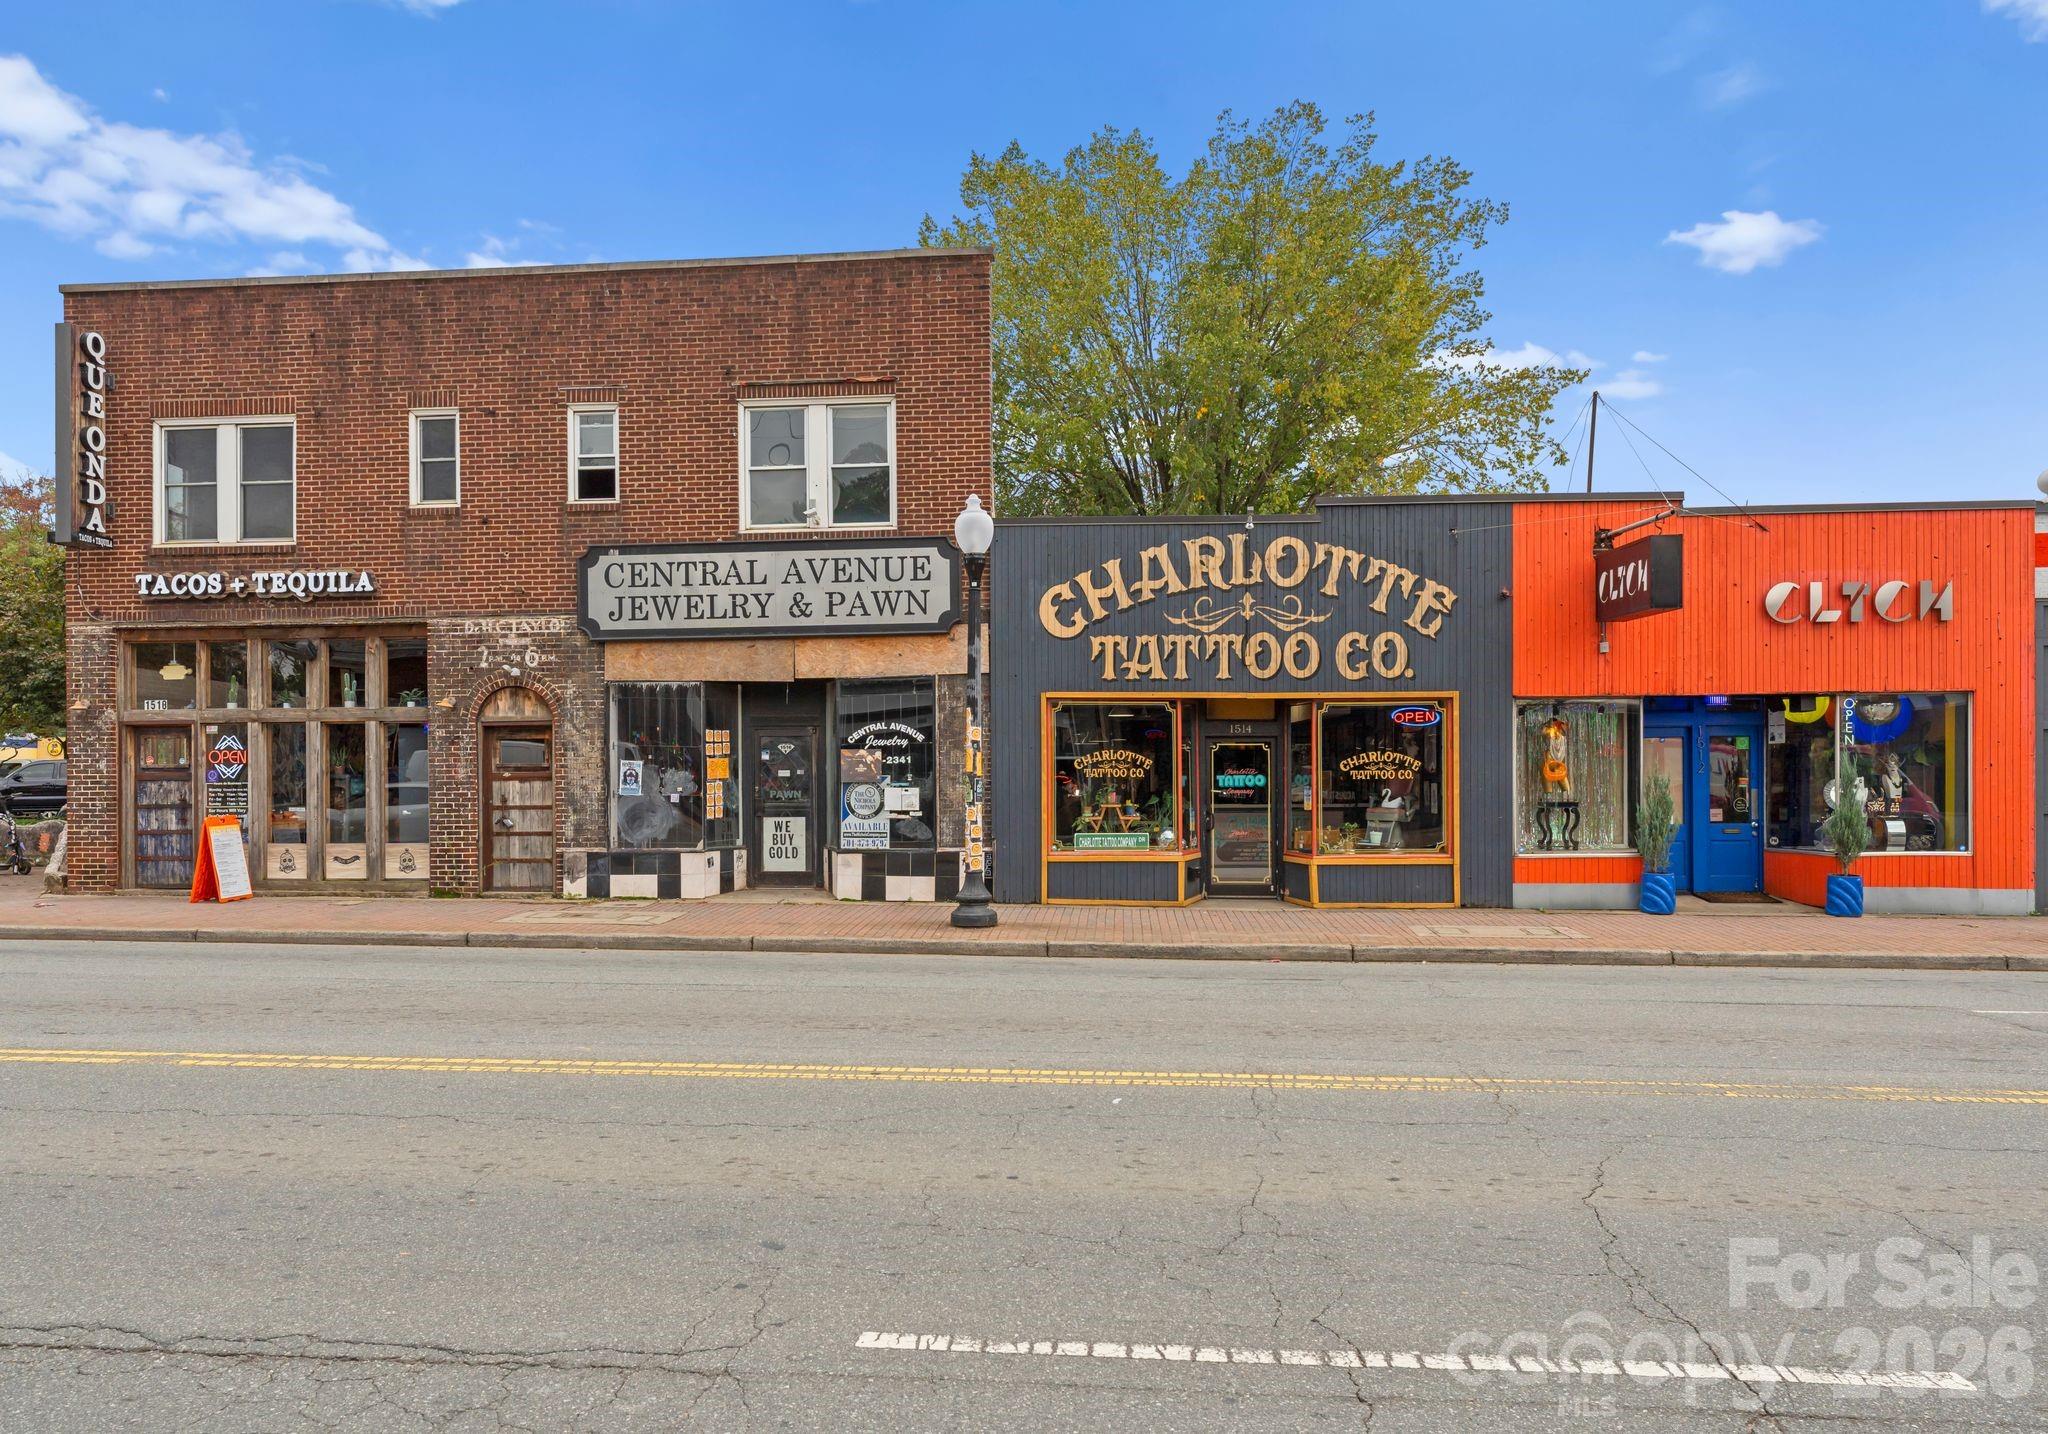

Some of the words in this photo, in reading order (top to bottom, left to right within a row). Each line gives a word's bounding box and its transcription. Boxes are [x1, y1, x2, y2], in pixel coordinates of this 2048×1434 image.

[85, 332, 106, 419] QUE
[85, 426, 107, 533] ONDA
[604, 559, 768, 588] CENTRAL
[781, 555, 931, 584] AVENUE
[135, 573, 222, 595] TACOS
[230, 577, 245, 592] +
[251, 571, 374, 597] TEQUILA
[1039, 532, 1458, 639] CHARLOTTE
[1598, 559, 1648, 603] CLTCH
[608, 592, 774, 622] JEWELRY
[788, 591, 813, 618] &
[825, 589, 930, 618] PAWN
[1765, 578, 1954, 623] CLTCH
[525, 647, 539, 667] 6
[1090, 631, 1321, 681] TATTOO
[1335, 631, 1415, 681] CO.
[145, 700, 167, 710] 1518
[1394, 711, 1435, 723] OPEN
[847, 722, 888, 743] CENTRAL
[890, 722, 925, 742] AVENUE
[1229, 724, 1252, 734] 1514
[865, 735, 909, 750] Jewelry
[208, 750, 247, 764] OPEN
[882, 755, 912, 764] -2341
[1074, 749, 1153, 770] CHARLOTTE
[1339, 751, 1422, 772] CHARLOTTE
[1083, 768, 1127, 778] TATTOO
[1129, 768, 1145, 778] CO.
[1350, 769, 1395, 780] TATTOO
[1397, 769, 1414, 780] CO.
[1216, 774, 1267, 788] TATTOO
[770, 790, 802, 799] PAWN
[1225, 788, 1255, 797] Company
[774, 820, 791, 833] WE
[843, 822, 889, 831] AVAILABLE
[772, 833, 795, 846] BUY
[1078, 837, 1102, 848] CHARLOTTE
[1102, 837, 1117, 847] TATTOO
[1117, 837, 1137, 848] COMPANY
[768, 846, 799, 859] GOLD
